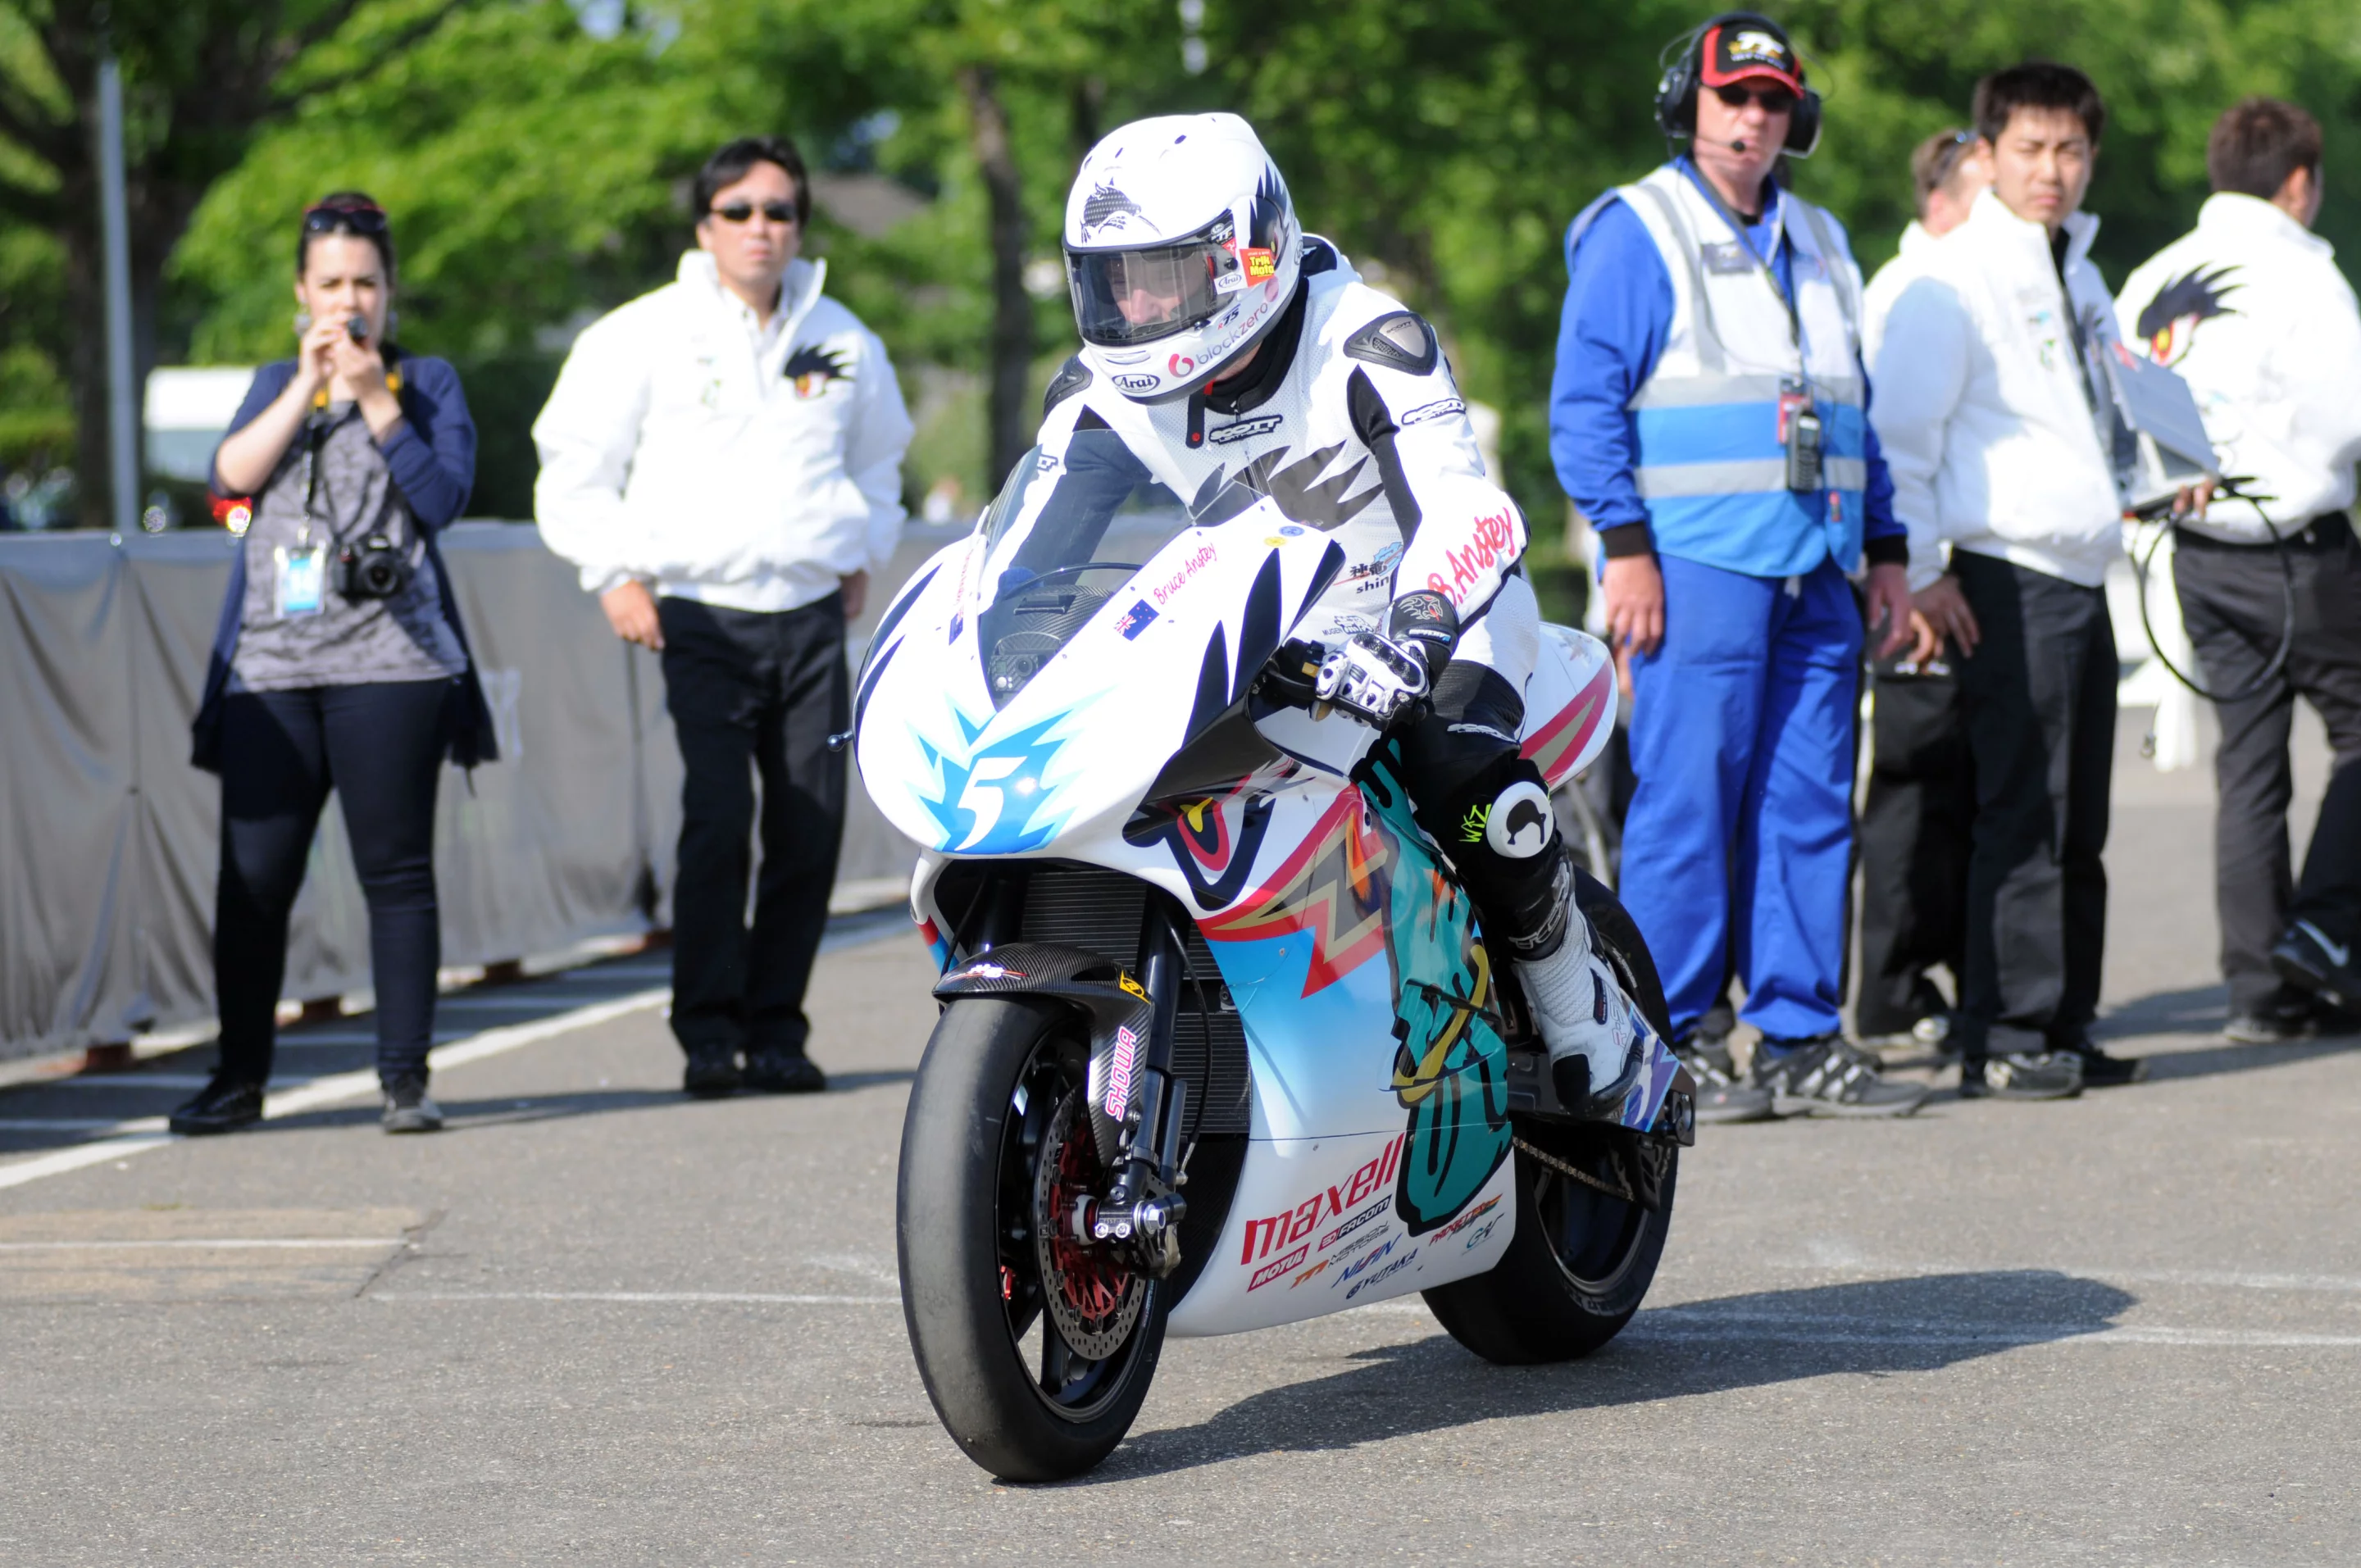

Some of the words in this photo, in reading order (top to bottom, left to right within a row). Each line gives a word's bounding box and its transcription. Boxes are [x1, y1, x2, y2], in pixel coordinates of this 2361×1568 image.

[1117, 375, 1154, 389] Arai
[1153, 572, 1185, 605] Bruce
[1185, 542, 1217, 577] Anstey
[954, 756, 1028, 852] 5
[1105, 1025, 1137, 1122] SHOWA
[1240, 1131, 1405, 1266] maxell
[1338, 1198, 1390, 1237] FACOM
[1250, 1248, 1306, 1288] MOTUL
